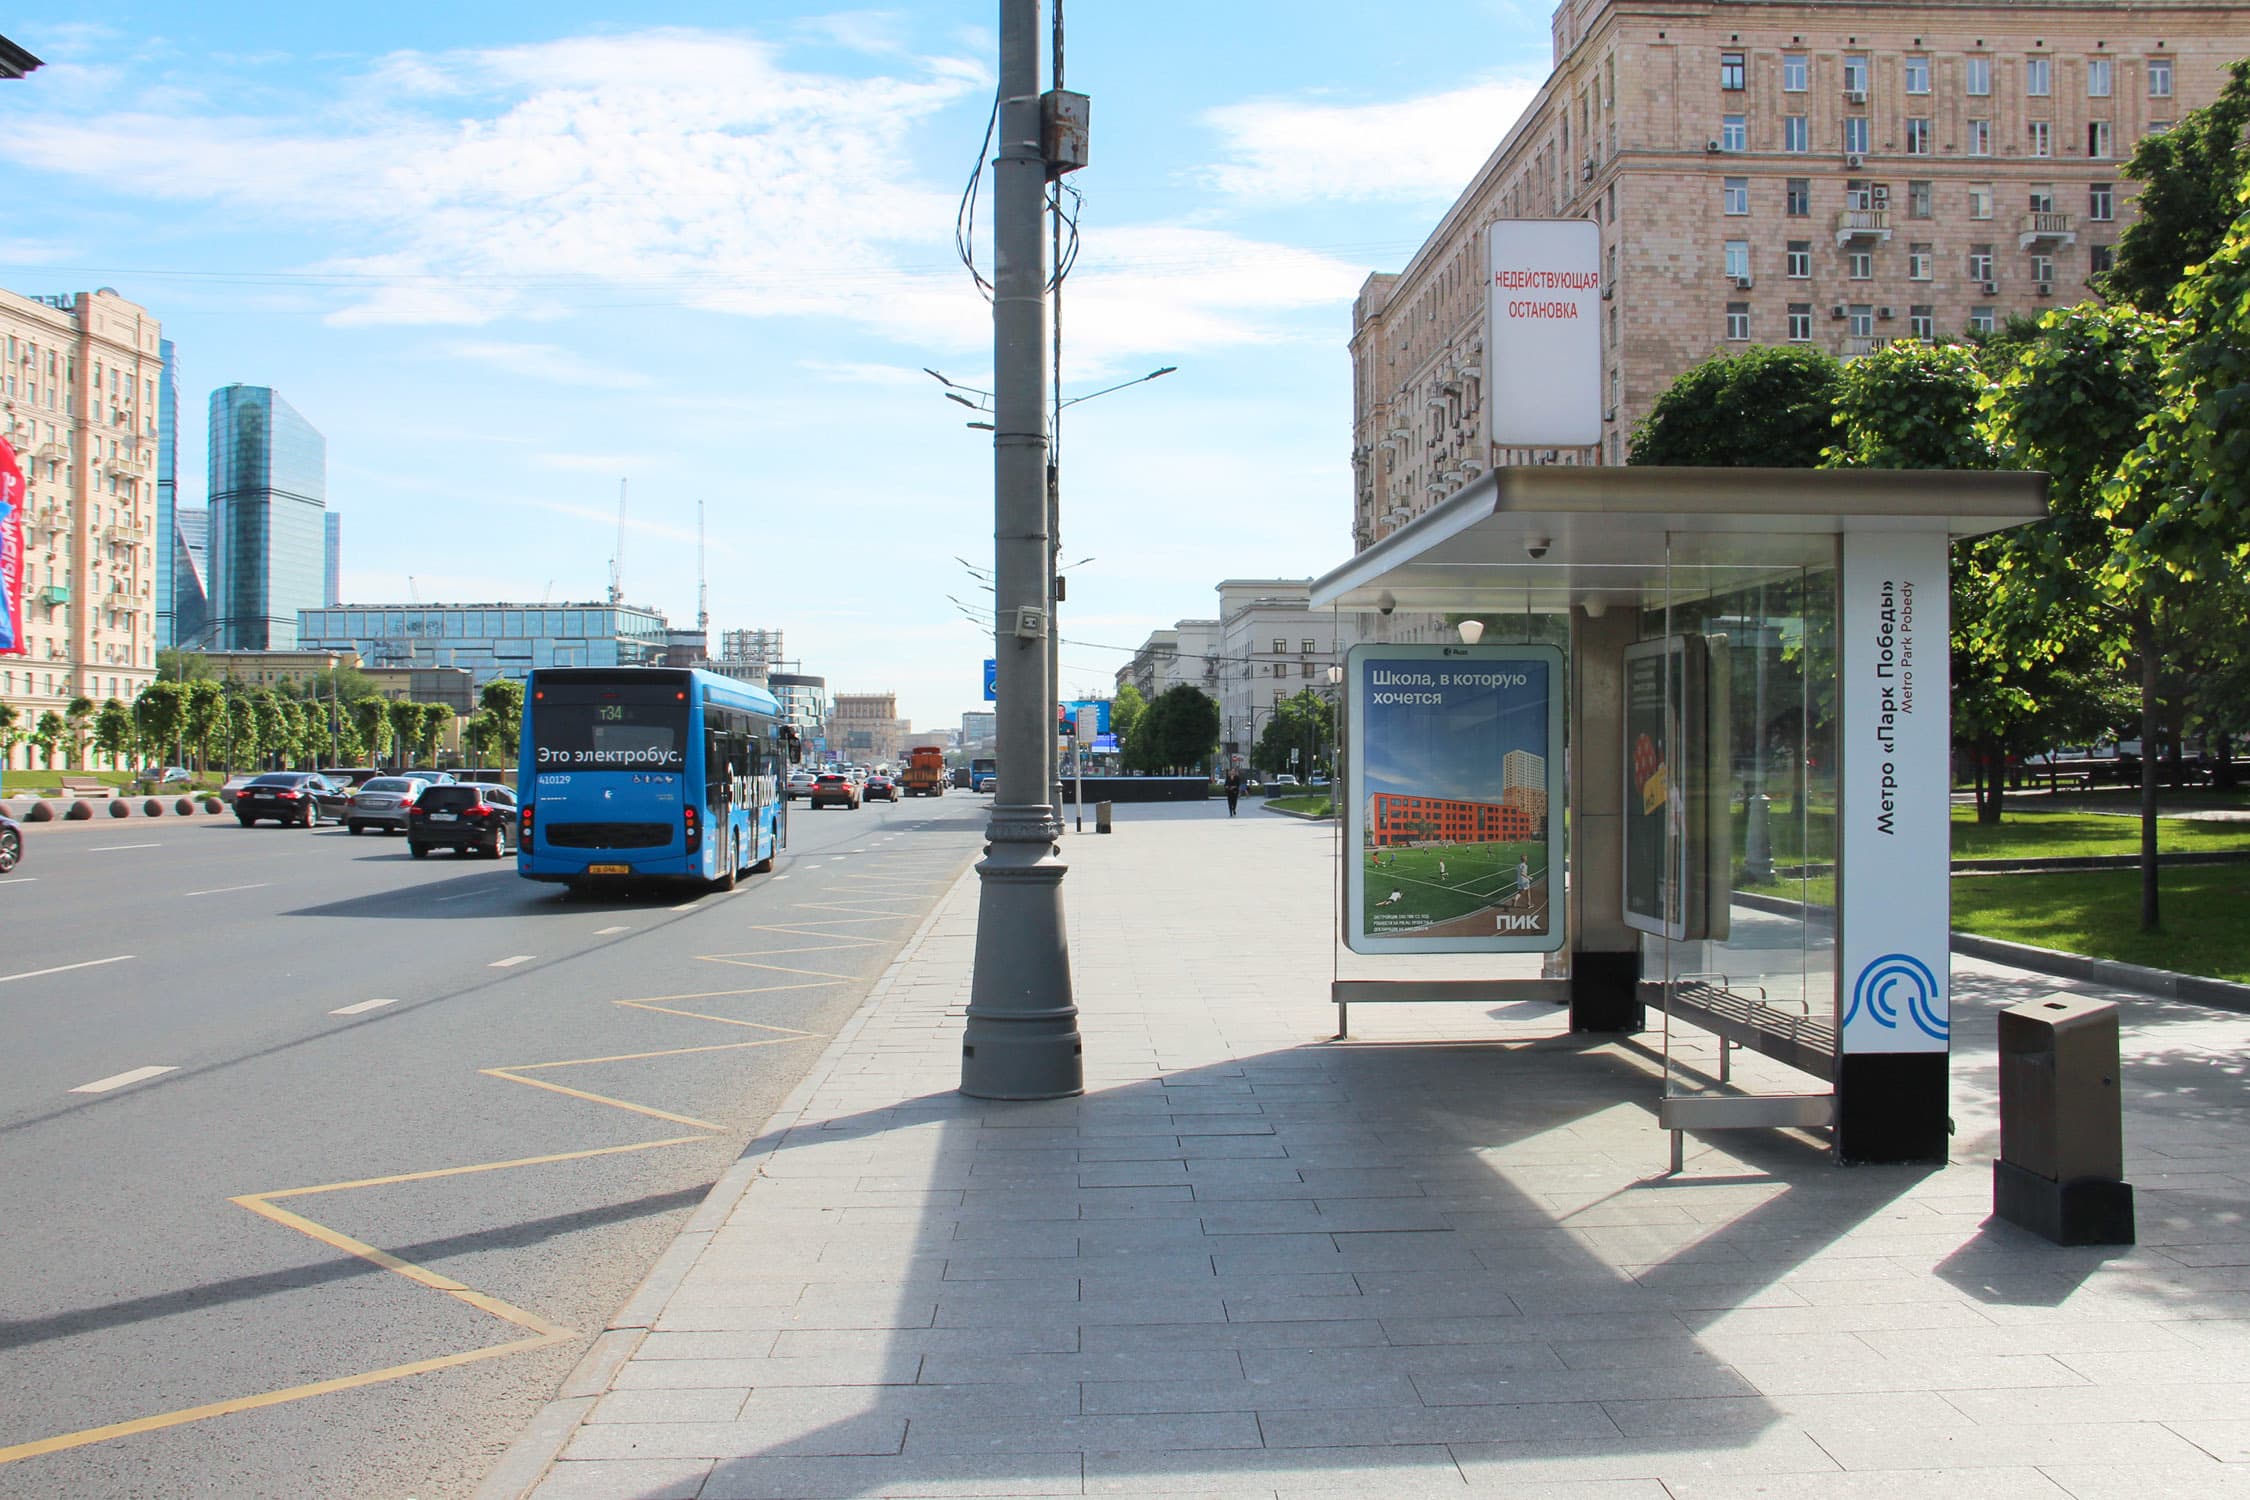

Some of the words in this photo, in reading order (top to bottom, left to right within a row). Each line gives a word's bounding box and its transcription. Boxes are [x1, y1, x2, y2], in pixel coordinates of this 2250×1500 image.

[1495, 268, 1599, 291] НЕДЕЙСТВУЮЩАЯ
[1509, 301, 1578, 319] ОСТАНОВКА
[1900, 581, 1915, 633] Pobedy
[1876, 580, 1896, 678] Победы»
[1901, 637, 1913, 668] Park
[1372, 670, 1436, 688] Школа,
[1439, 674, 1449, 686] в
[1453, 673, 1527, 688] которую
[1372, 690, 1442, 705] хочется
[1901, 671, 1913, 714] Metro
[1877, 687, 1898, 754] «Парк
[538, 748, 570, 763] Это
[574, 746, 683, 766] электробус.
[538, 775, 571, 785] 410129
[1877, 762, 1898, 836] Метро
[1496, 915, 1541, 930] ПИК
